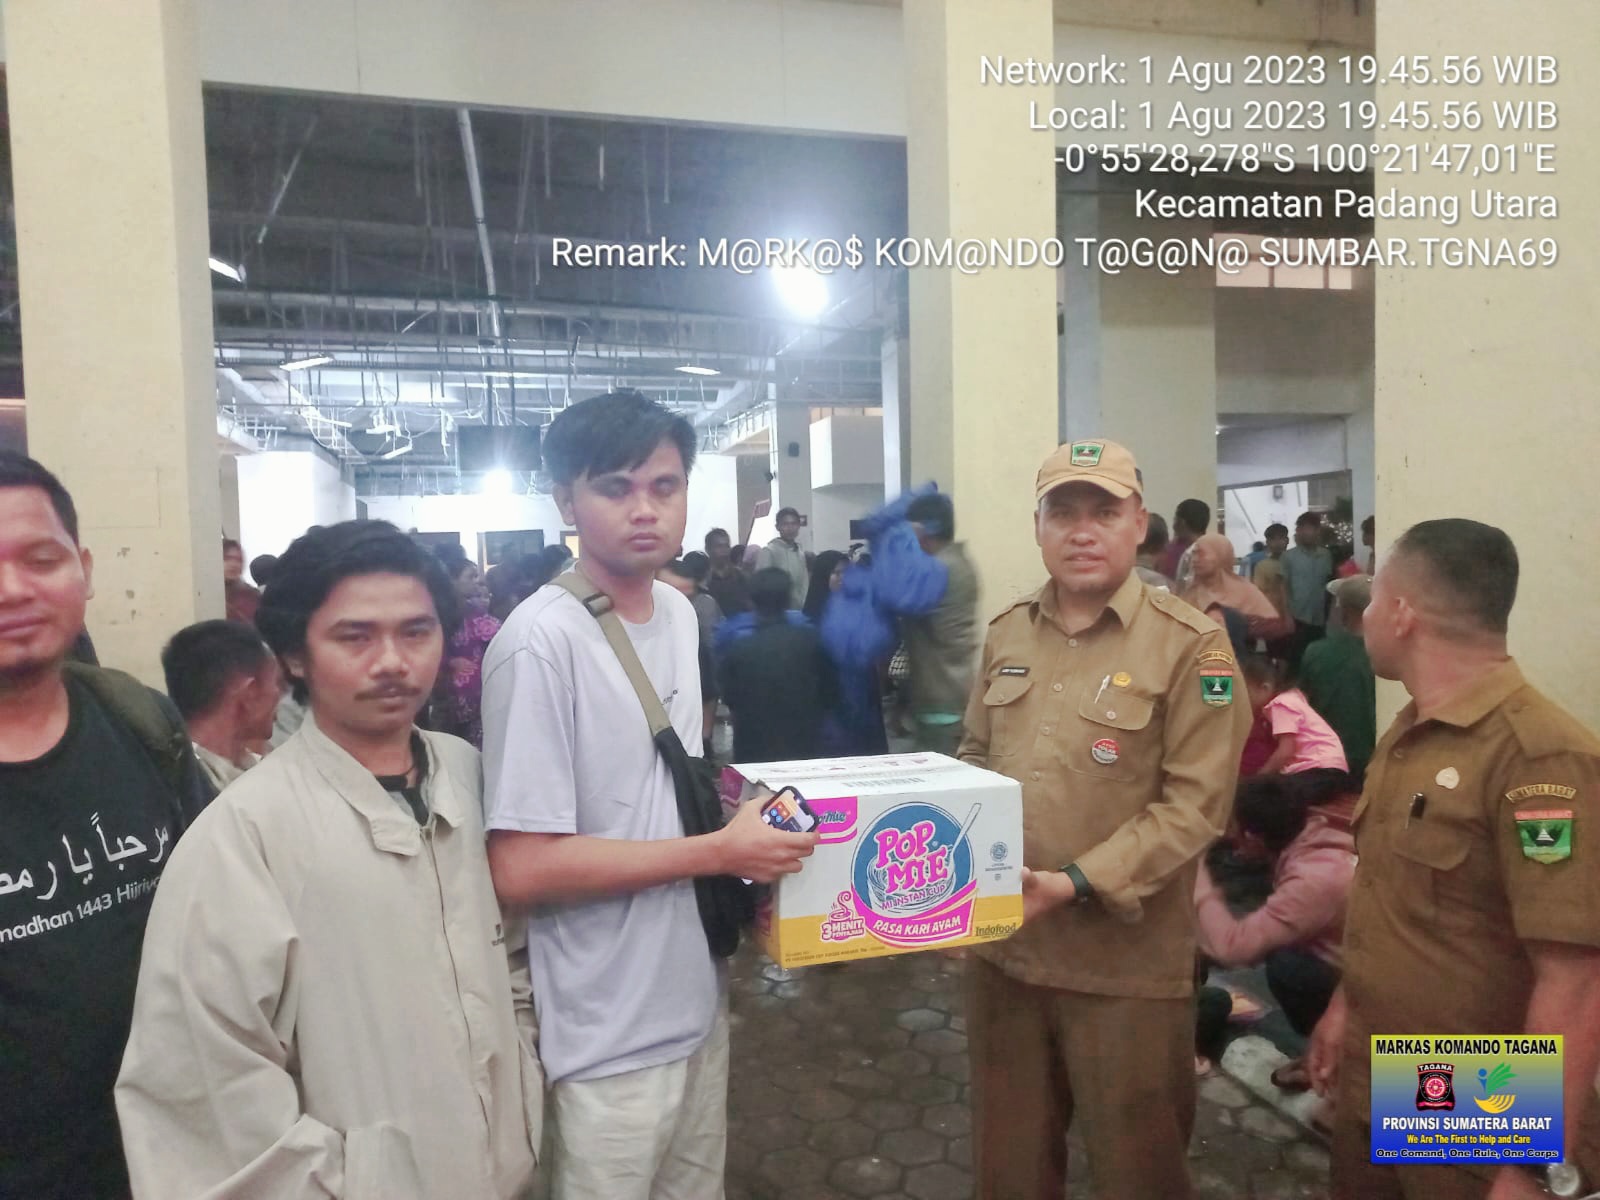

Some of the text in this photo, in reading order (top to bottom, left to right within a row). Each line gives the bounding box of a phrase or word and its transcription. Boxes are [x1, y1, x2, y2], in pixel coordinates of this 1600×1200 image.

[62, 834, 94, 885] يا
[875, 821, 935, 869] POP
[886, 847, 949, 894] MIE
[881, 884, 946, 910] MI INSTAN CUP
[0, 910, 74, 942] madhan
[77, 893, 113, 919] 1443
[821, 919, 863, 939] 3 MENIT
[873, 915, 961, 936] RASA KARI AYAM
[976, 922, 1017, 937] Indofood
